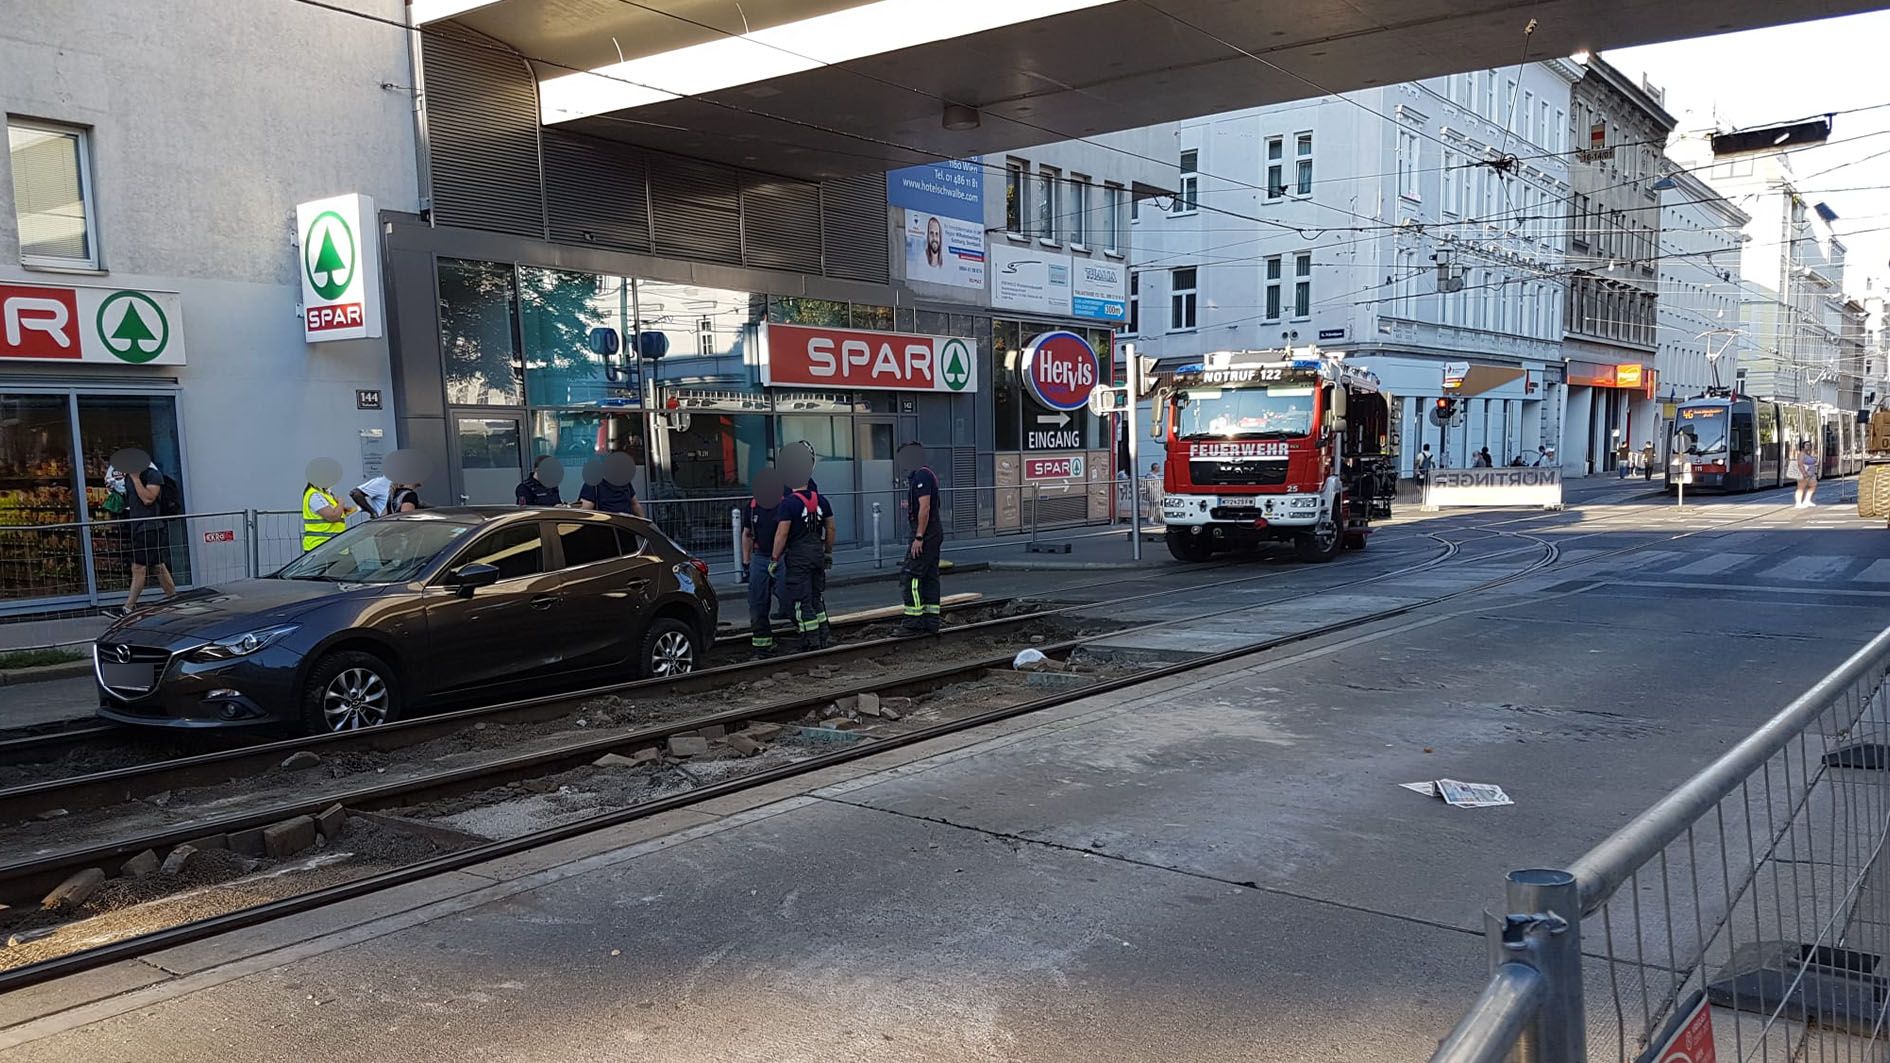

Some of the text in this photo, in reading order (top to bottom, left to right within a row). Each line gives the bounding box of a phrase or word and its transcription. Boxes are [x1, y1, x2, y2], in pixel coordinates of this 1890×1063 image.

[934, 169, 945, 180] Tel.
[902, 178, 979, 202] www.hotelschwalbe.com
[308, 306, 361, 328] SPAR
[807, 337, 932, 381] SPAR
[1039, 349, 1093, 392] Hervis
[1203, 368, 1282, 383] NOTRUF 122
[360, 392, 379, 402] 144
[1028, 430, 1080, 449] EINGANG
[1189, 442, 1289, 457] FEUERWEHR
[1034, 462, 1070, 475] SPAR
[1286, 484, 1298, 493] 25
